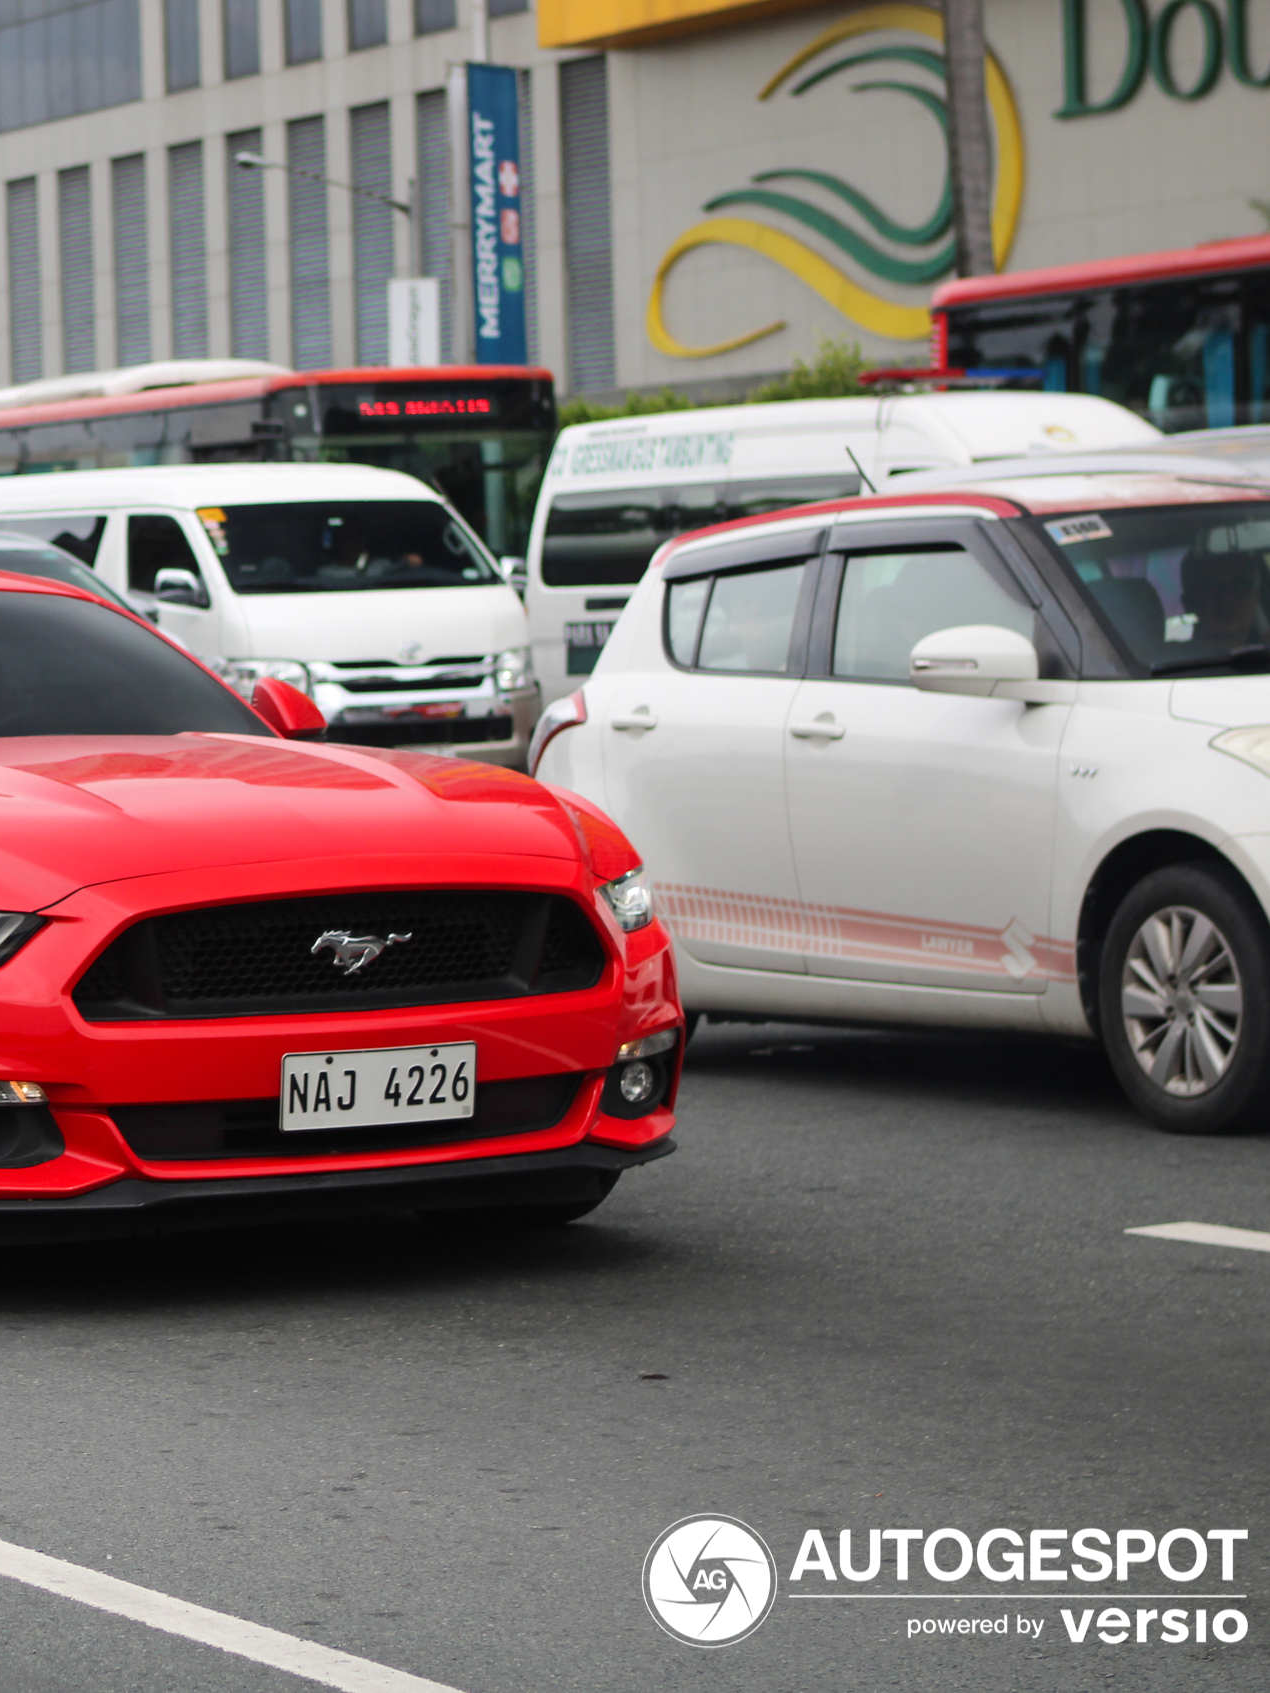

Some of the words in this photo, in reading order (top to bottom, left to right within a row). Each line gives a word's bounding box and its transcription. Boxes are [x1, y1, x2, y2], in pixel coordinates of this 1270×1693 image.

[473, 111, 500, 338] MERRYMART
[288, 1069, 356, 1114] NAJ
[384, 1061, 469, 1107] 4226
